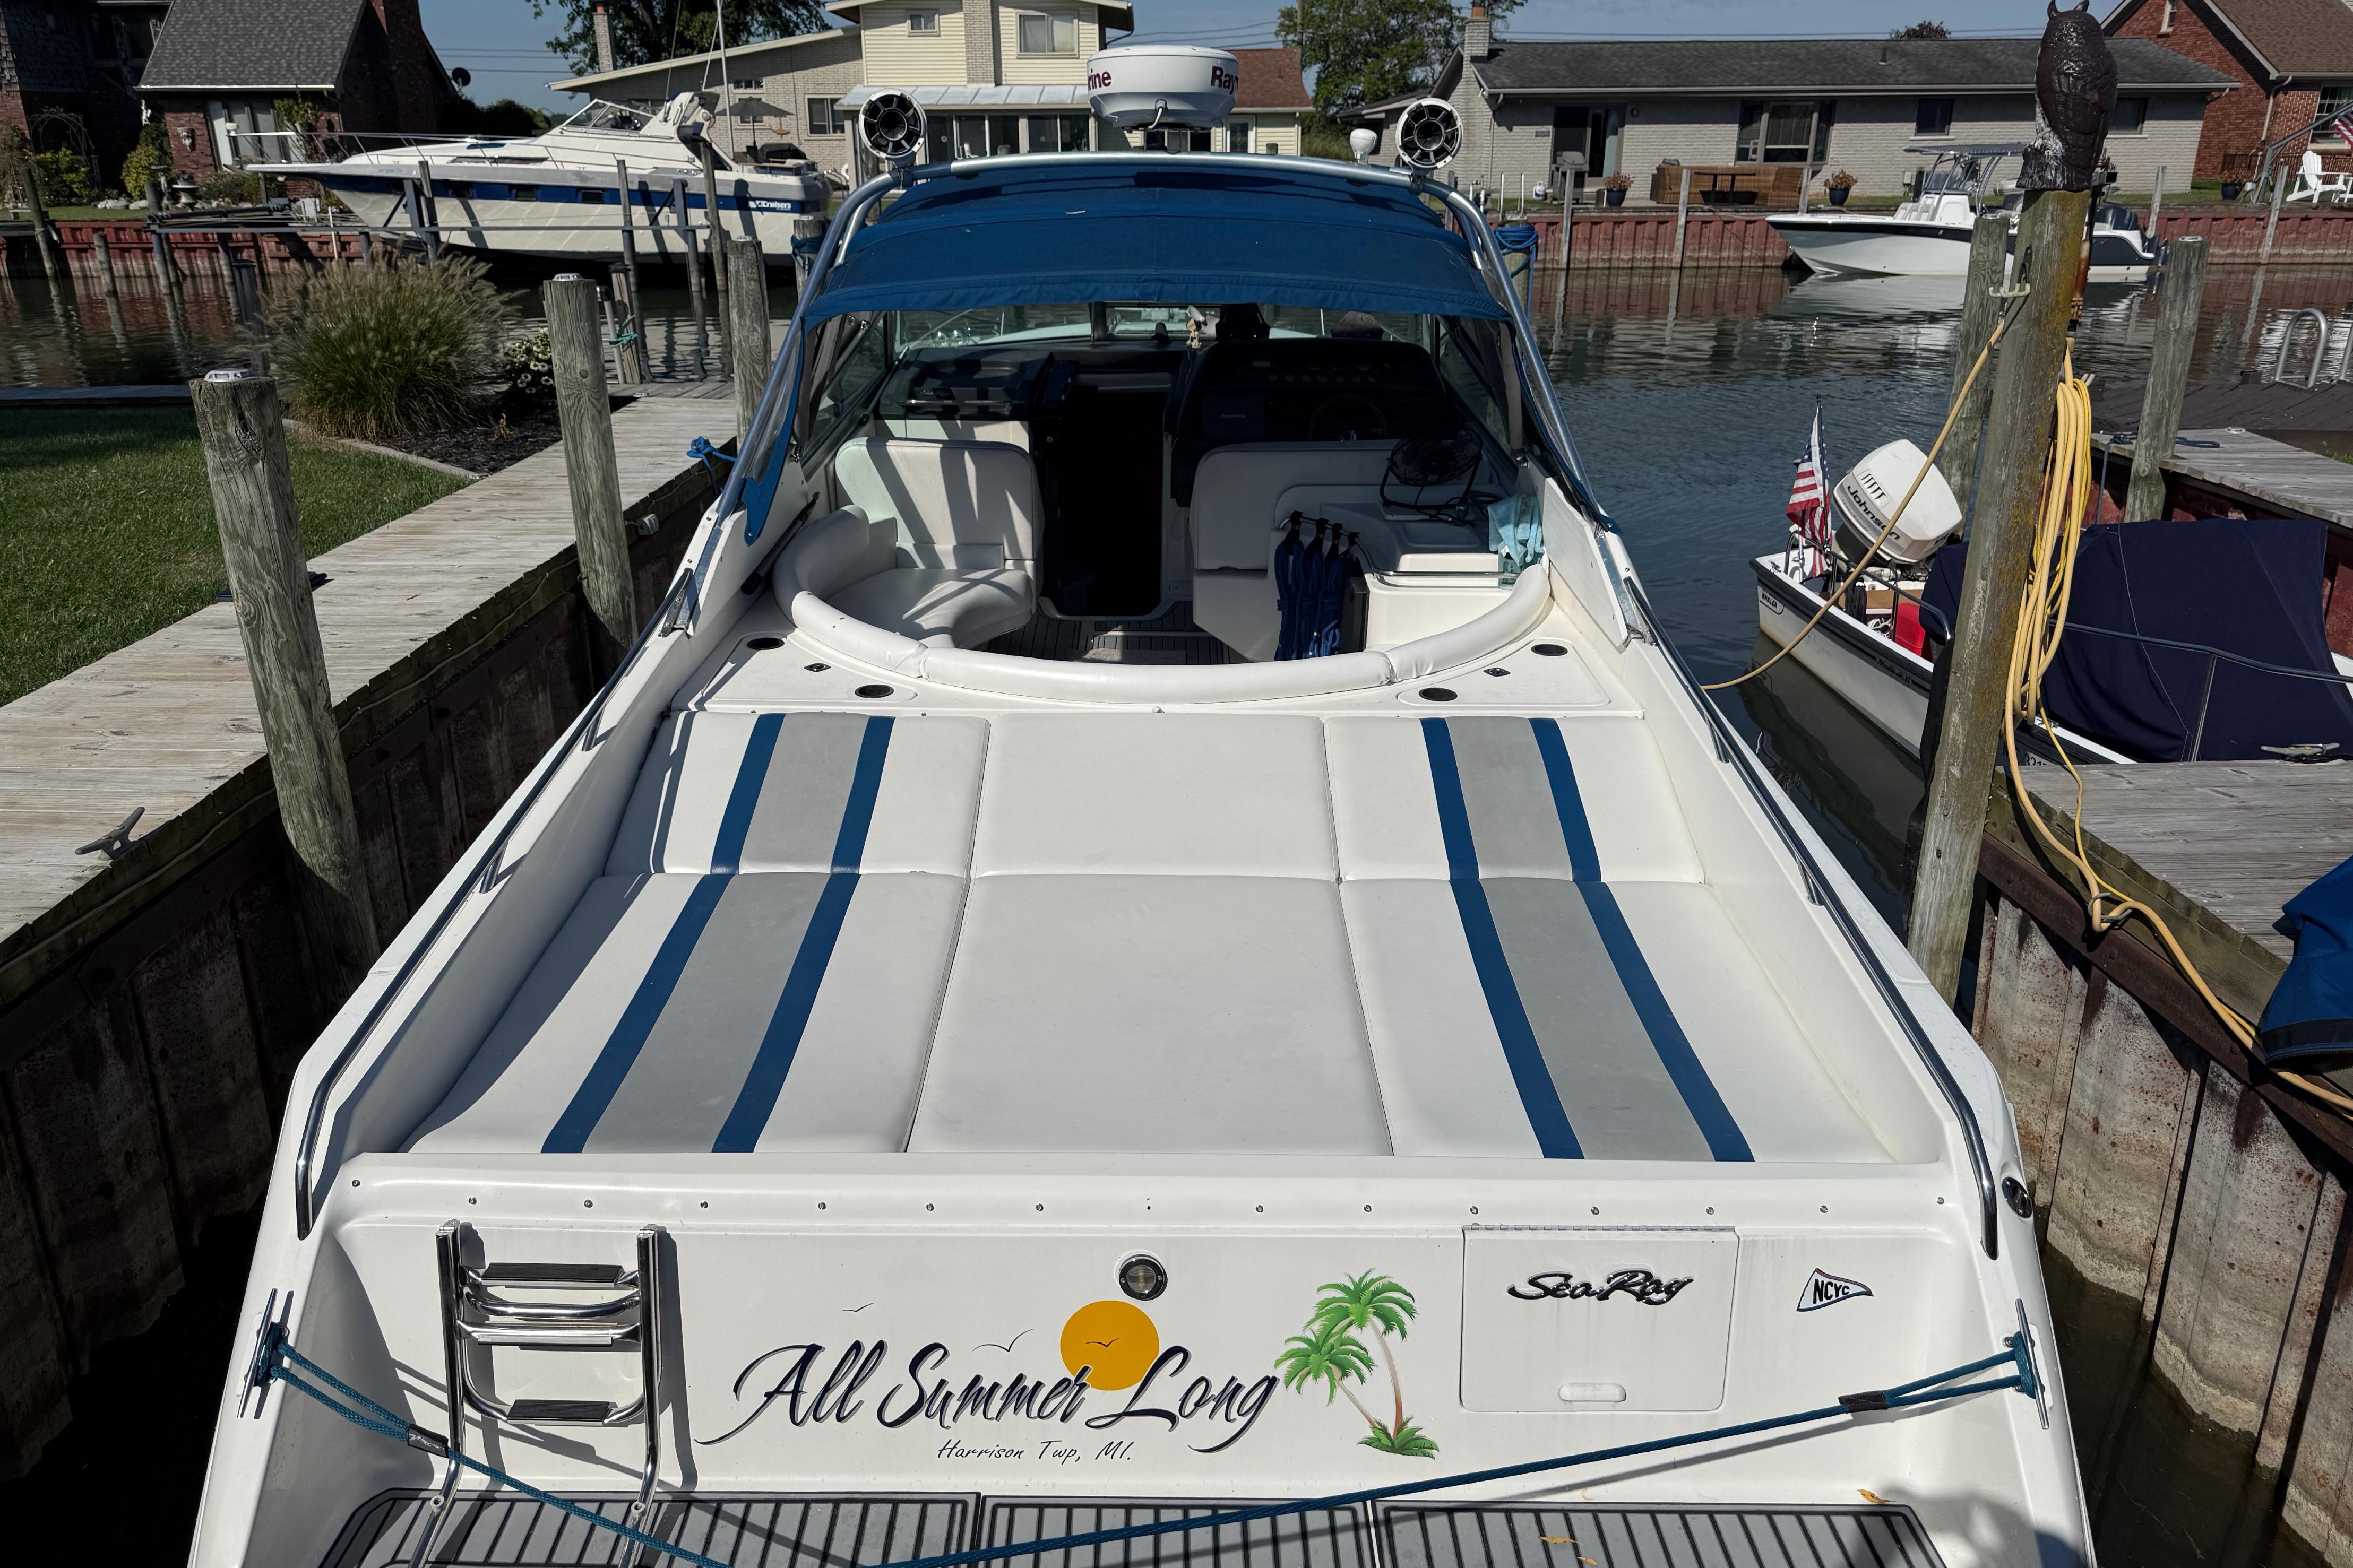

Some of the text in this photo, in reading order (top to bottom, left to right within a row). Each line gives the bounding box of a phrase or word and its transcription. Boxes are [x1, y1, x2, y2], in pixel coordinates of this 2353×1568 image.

[1088, 68, 1111, 91] rine
[1813, 1279, 1850, 1304] NCYC
[693, 1339, 1280, 1454] All Summer Long
[937, 1439, 1135, 1466] Harrison Twp, MI.
